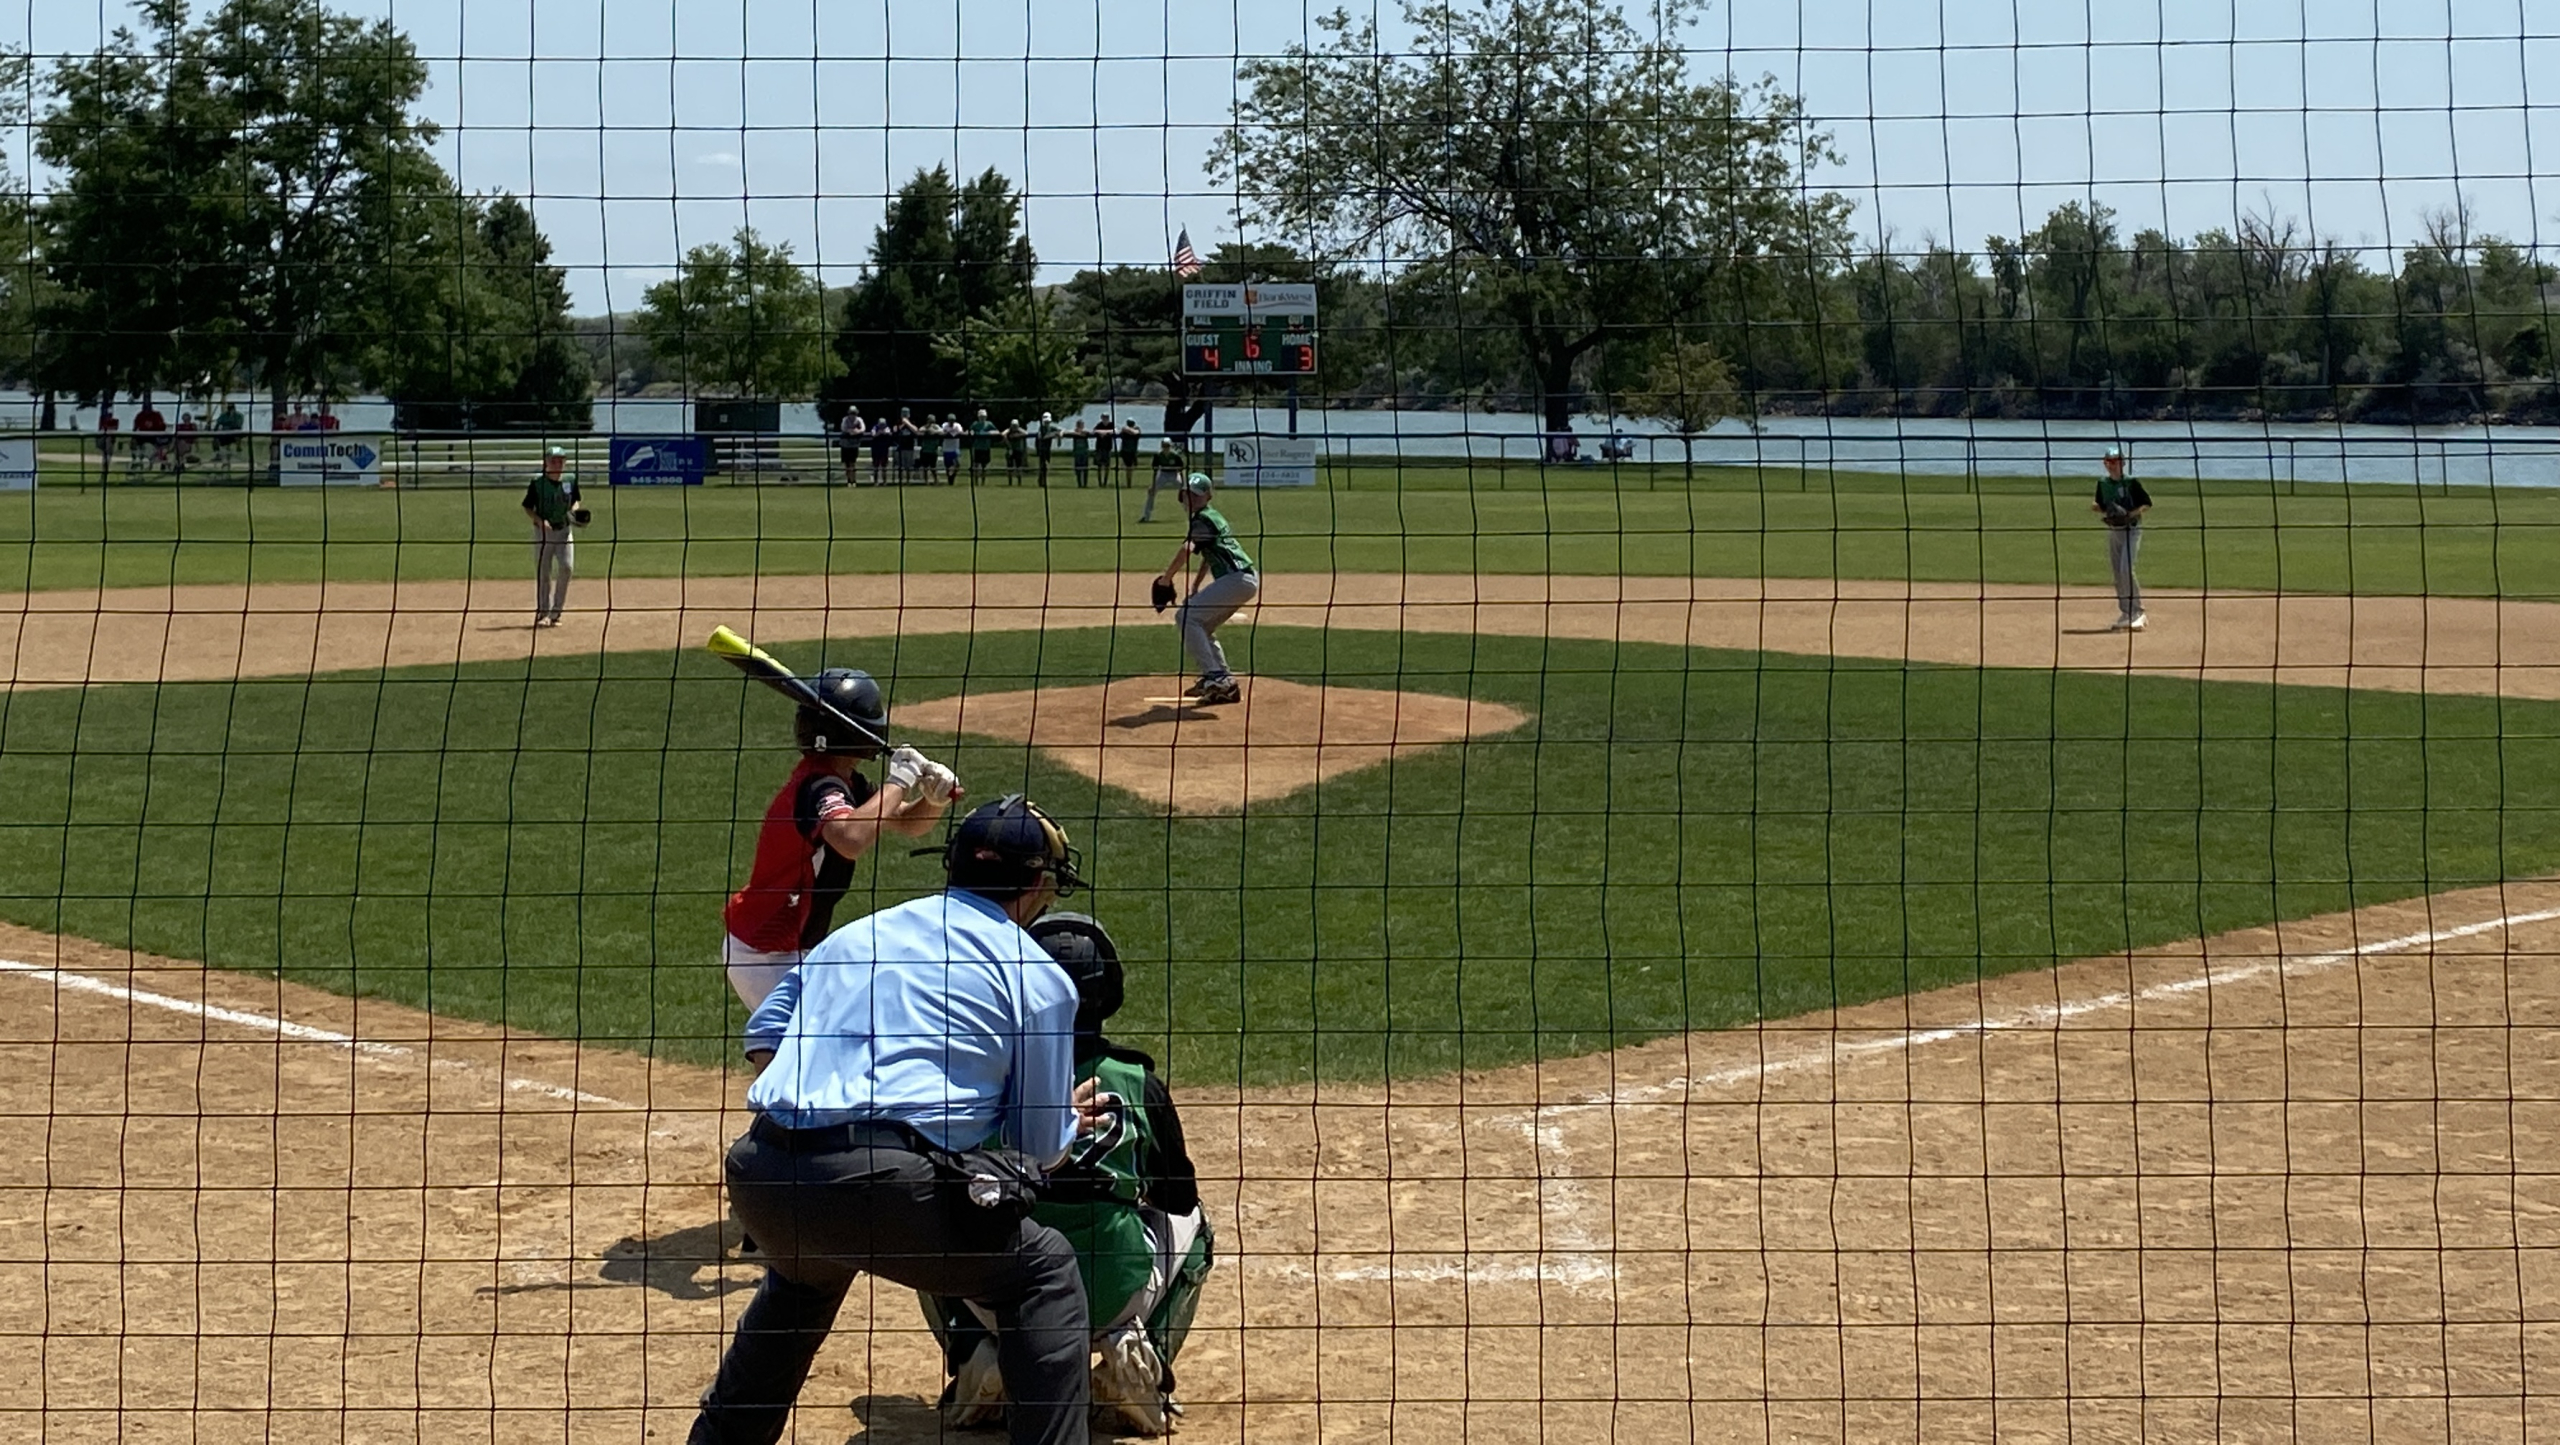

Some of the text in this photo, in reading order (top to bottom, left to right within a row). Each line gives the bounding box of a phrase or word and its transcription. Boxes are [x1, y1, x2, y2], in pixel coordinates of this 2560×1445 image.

[1186, 289, 1237, 299] GRIFFIN
[1194, 299, 1230, 309] FIELD
[1186, 334, 1220, 346] GUEST
[1282, 333, 1312, 345] HOME
[1245, 335, 1260, 358] 6
[1204, 348, 1220, 369] 4
[1300, 346, 1314, 370] 3
[1234, 360, 1273, 372] INNING
[283, 443, 363, 458] CommTech
